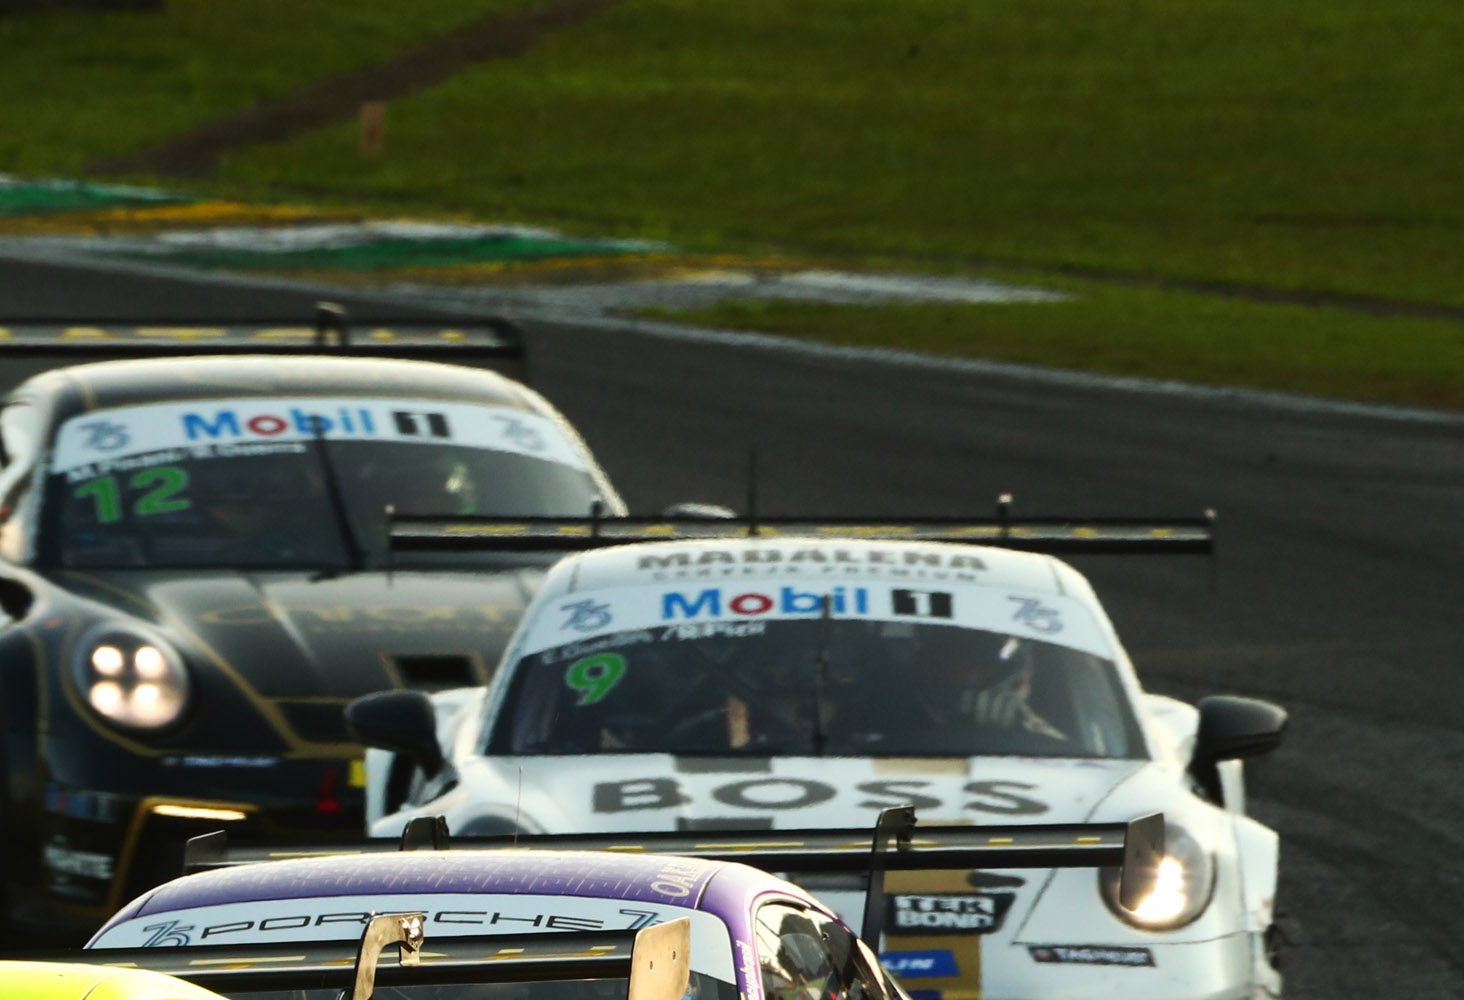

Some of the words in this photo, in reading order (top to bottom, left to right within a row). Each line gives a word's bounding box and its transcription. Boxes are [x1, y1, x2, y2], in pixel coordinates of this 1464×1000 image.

[181, 407, 375, 440] Mobil
[74, 465, 192, 524] 12
[639, 548, 988, 571] MADALENA
[661, 585, 868, 619] Mobil
[564, 651, 628, 707] 9
[592, 776, 1050, 817] BOSS
[201, 908, 605, 940] PORCHE
